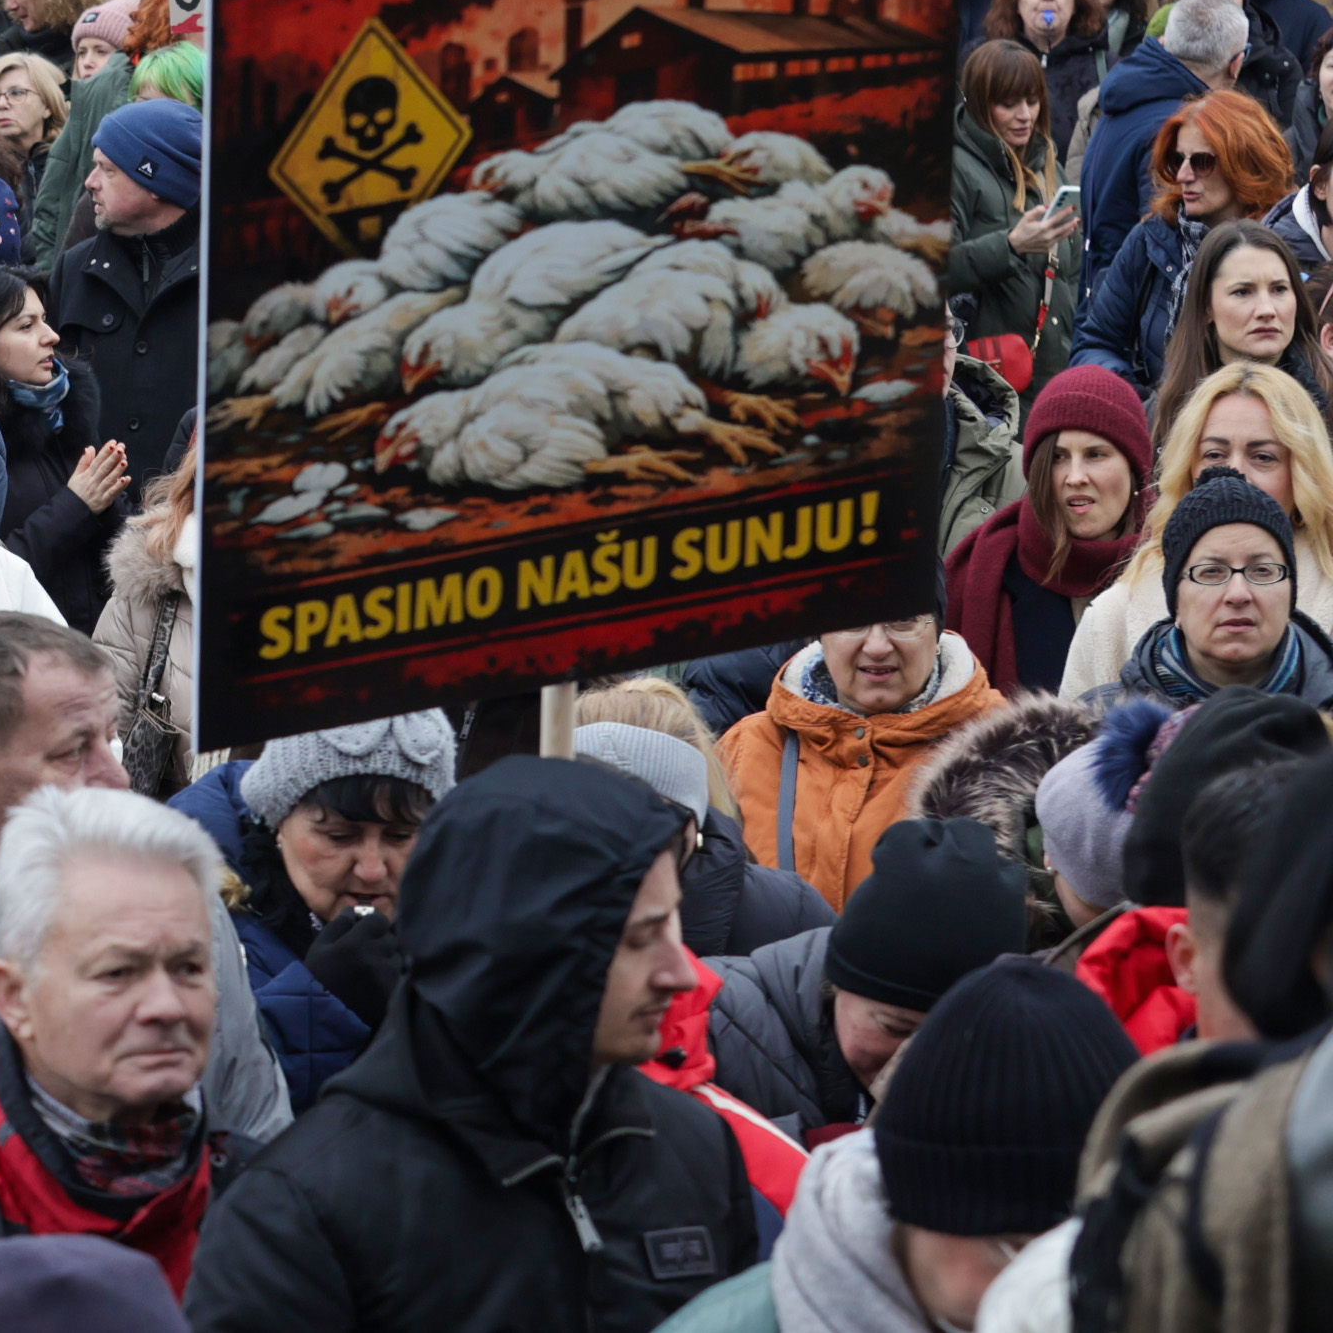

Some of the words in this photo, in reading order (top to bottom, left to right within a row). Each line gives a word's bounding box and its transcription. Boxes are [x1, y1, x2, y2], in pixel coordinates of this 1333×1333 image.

[258, 567, 503, 661] SPASIMO
[517, 529, 657, 611] NAŠU
[671, 490, 881, 580] SUNJU!
